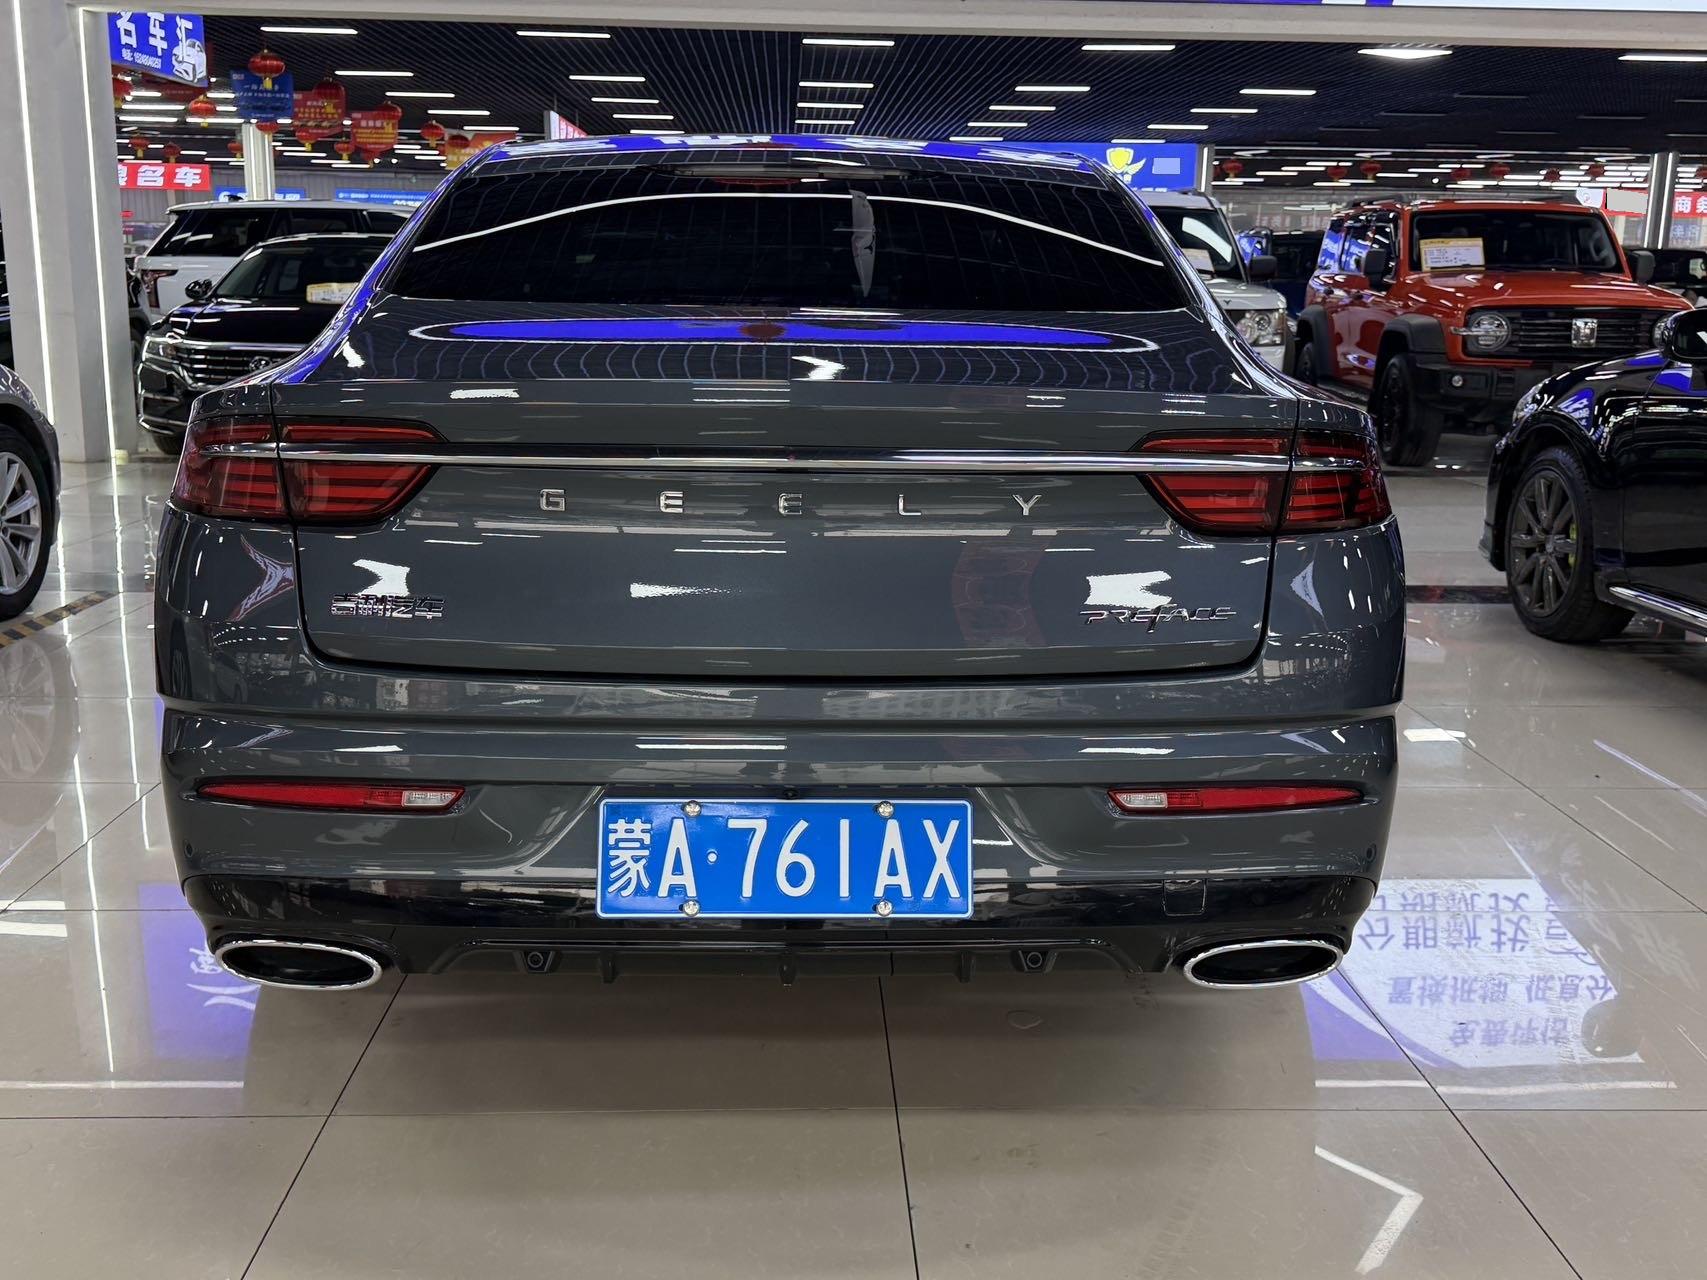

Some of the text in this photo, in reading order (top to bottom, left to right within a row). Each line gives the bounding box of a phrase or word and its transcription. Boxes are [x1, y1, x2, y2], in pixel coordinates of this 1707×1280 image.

[540, 489, 1042, 517] GEELY
[331, 593, 445, 619] 吉利汽车
[1080, 603, 1237, 633] PREFACE
